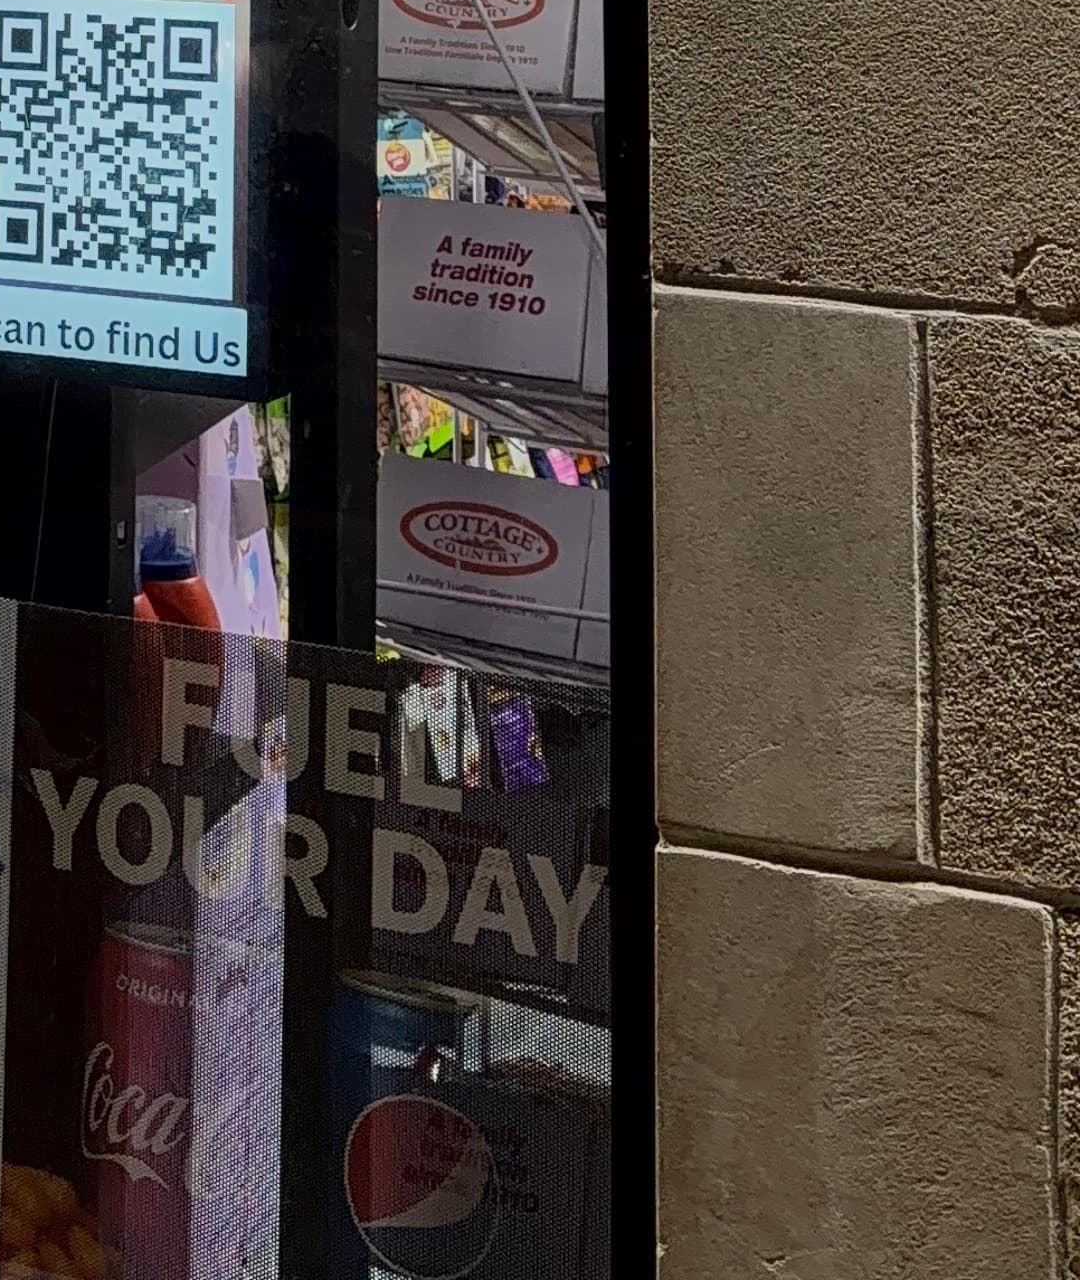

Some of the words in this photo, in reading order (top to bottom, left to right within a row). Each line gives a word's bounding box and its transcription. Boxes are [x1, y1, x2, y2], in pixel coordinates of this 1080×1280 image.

[436, 235, 454, 255] A
[460, 236, 533, 267] family
[430, 258, 534, 290] tradition
[412, 282, 479, 308] since
[487, 290, 546, 316] 1910
[55, 317, 95, 353] to
[106, 318, 180, 362] find
[194, 331, 241, 368] Us
[424, 513, 535, 552] COTTAGE
[433, 537, 521, 564] COUNTRY
[161, 657, 464, 814] FUEL
[30, 767, 329, 920] YOUR
[370, 826, 608, 966] DAY
